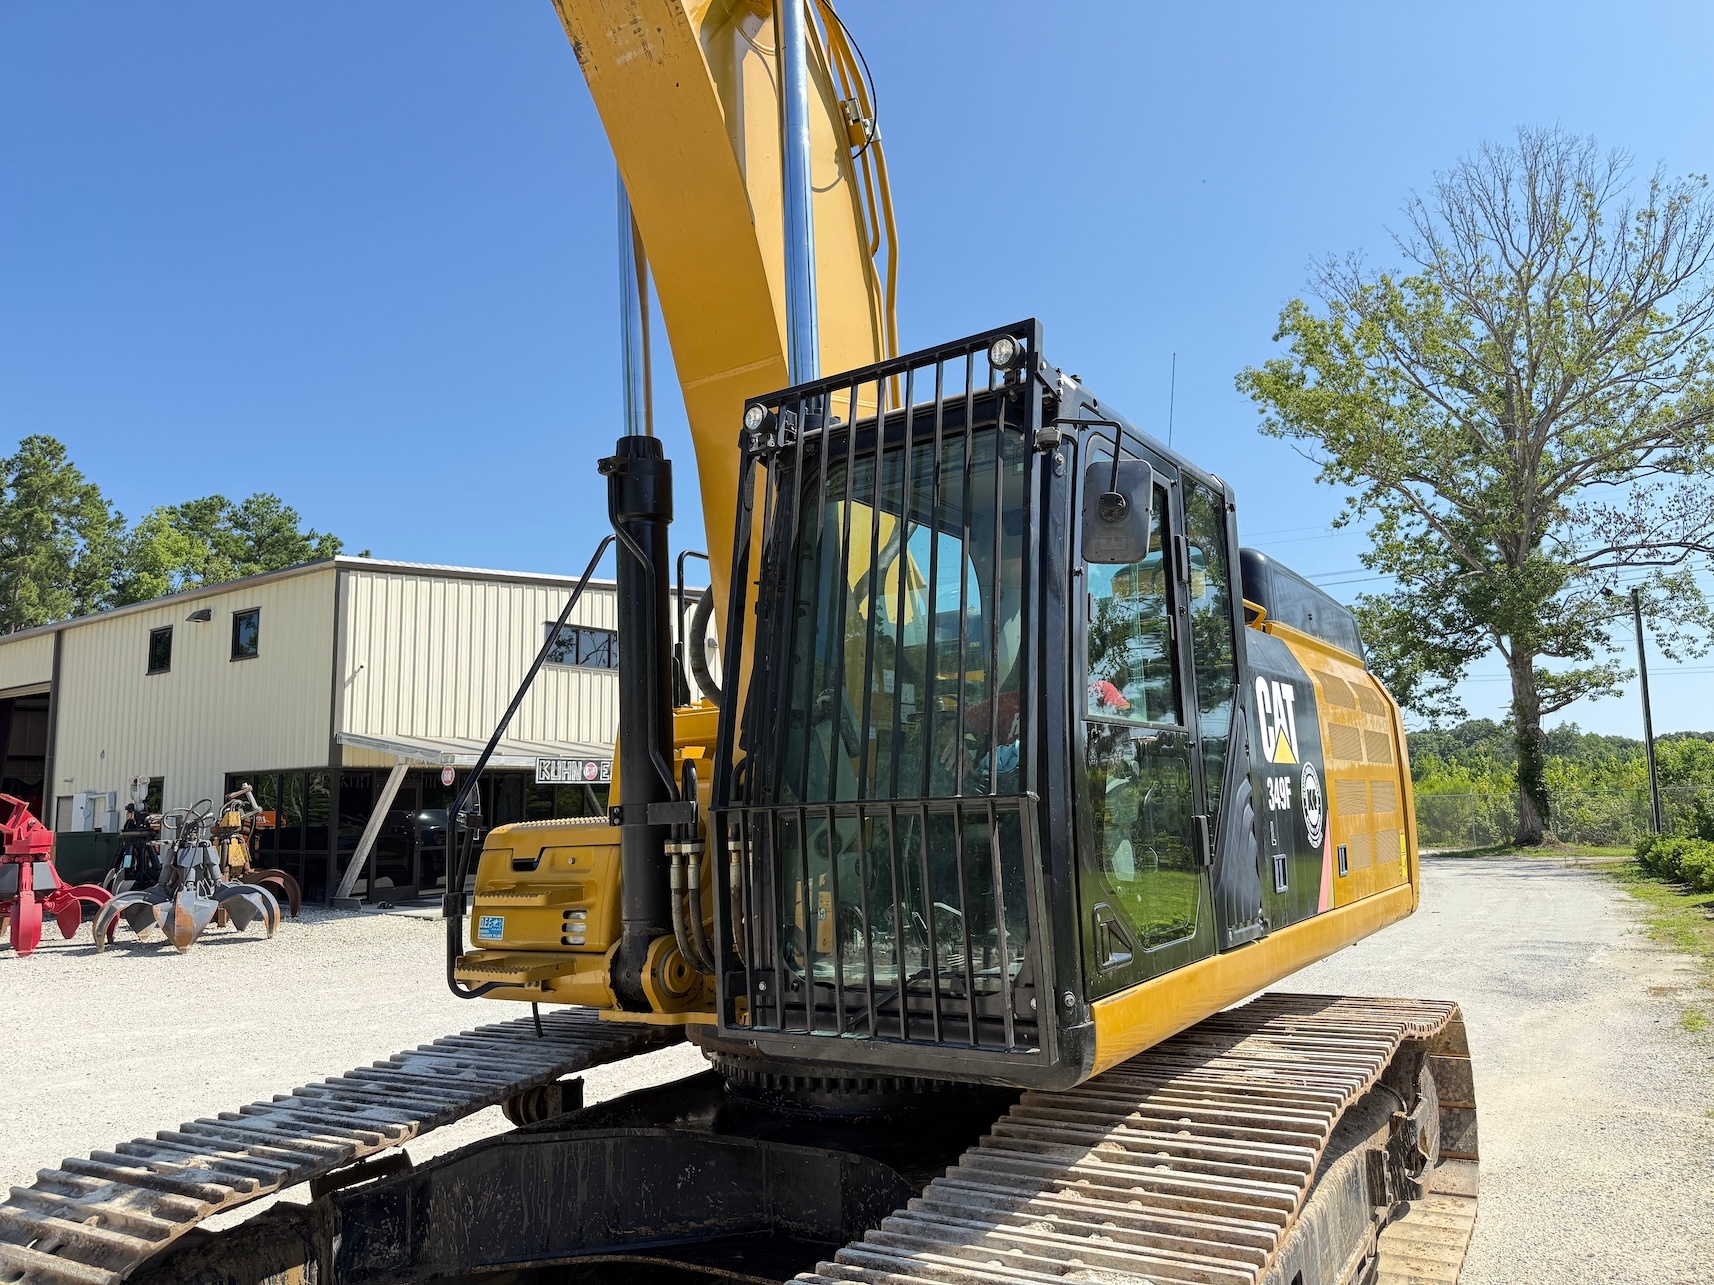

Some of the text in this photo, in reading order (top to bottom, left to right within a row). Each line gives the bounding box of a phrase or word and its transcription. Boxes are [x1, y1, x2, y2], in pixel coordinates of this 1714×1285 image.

[1255, 675, 1300, 764] CAT
[539, 759, 583, 781] KUHN
[1266, 776, 1292, 812] 349F
